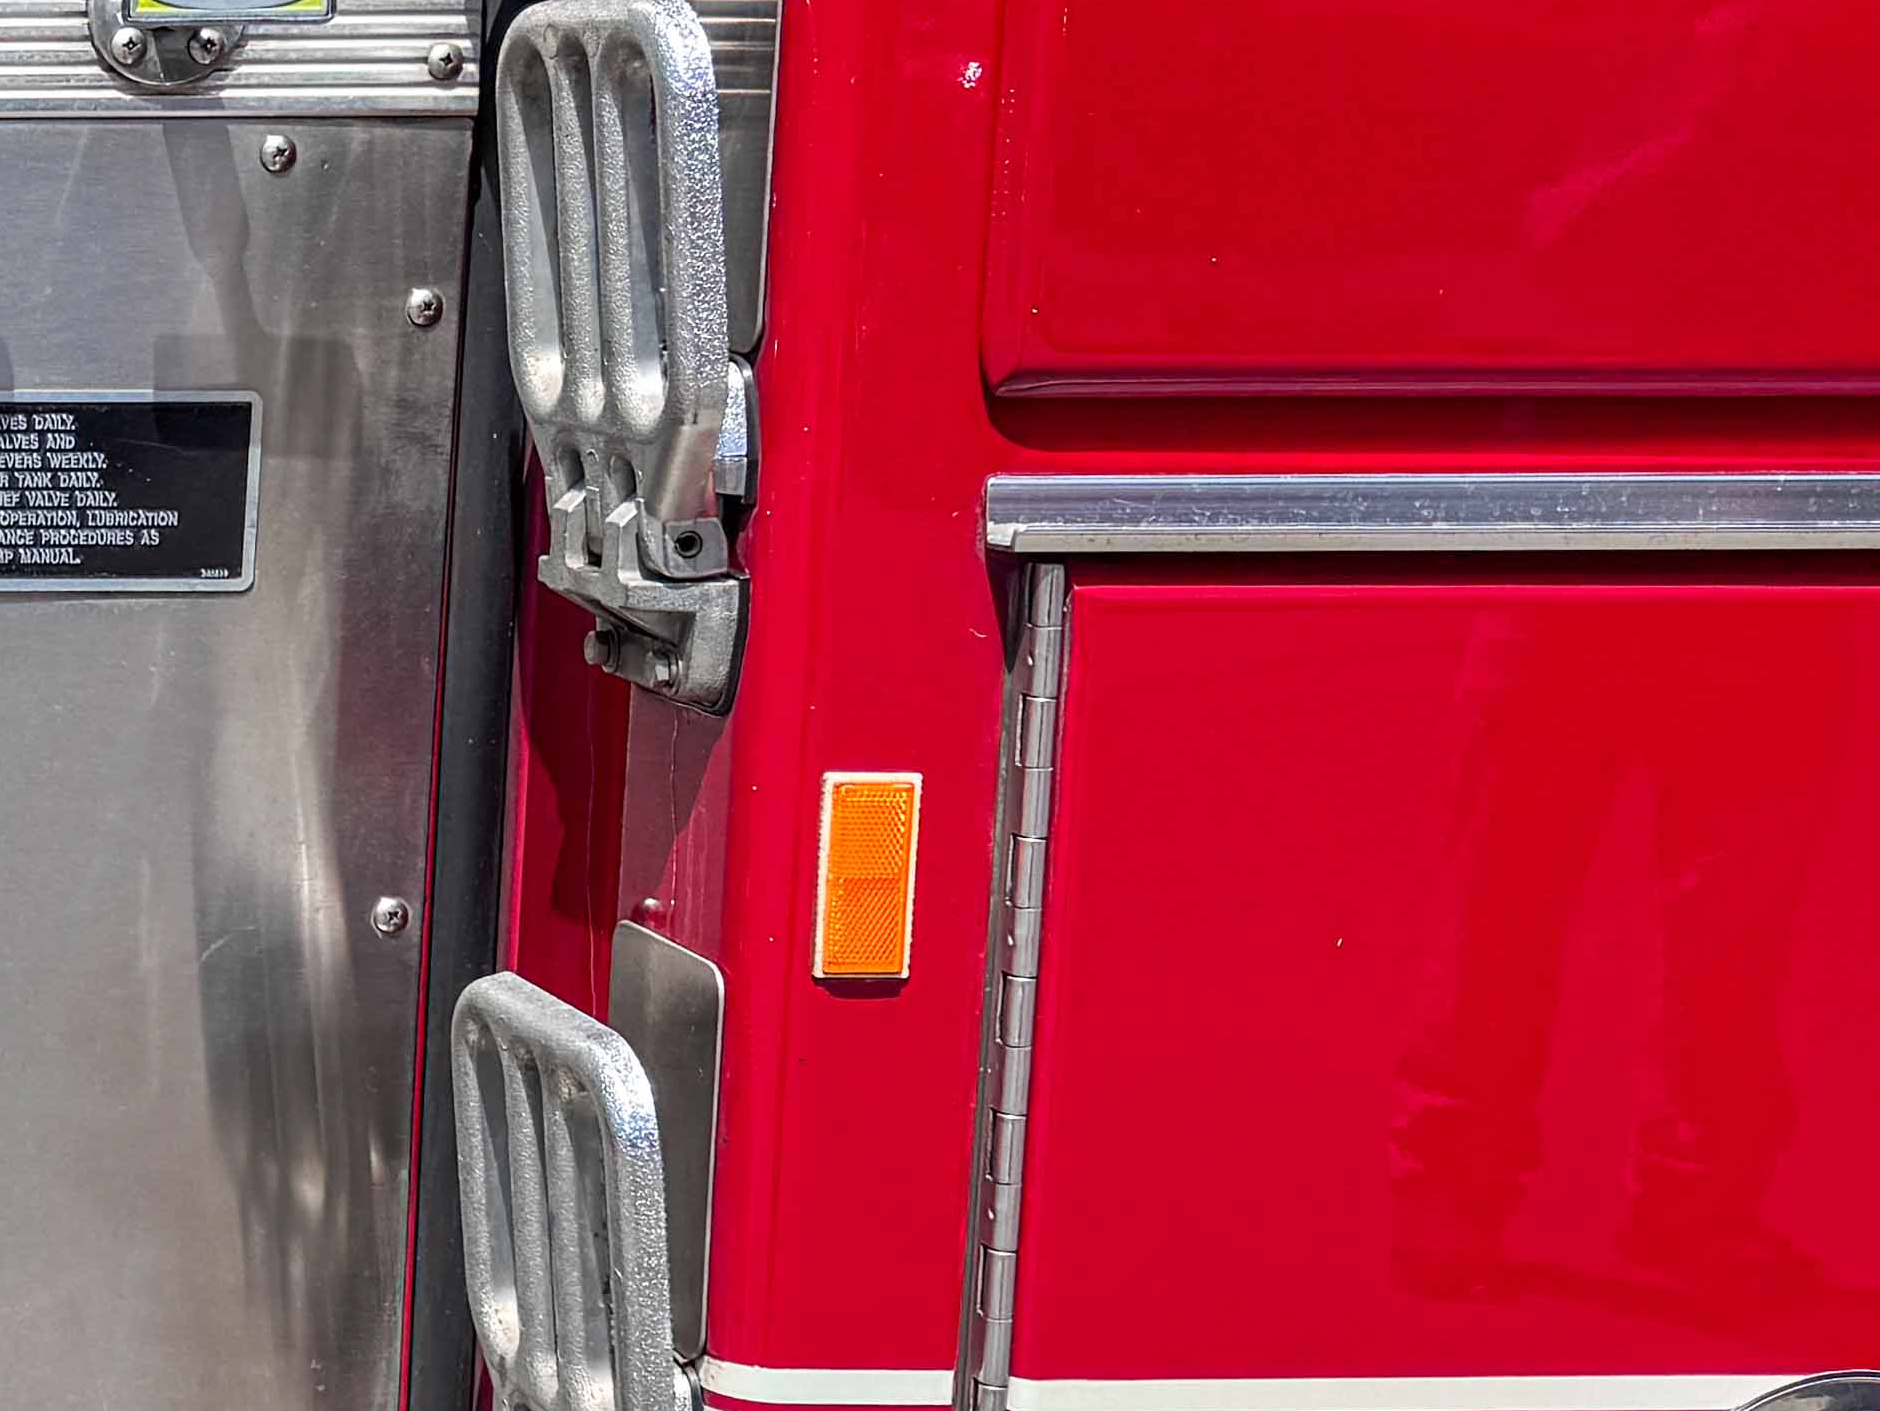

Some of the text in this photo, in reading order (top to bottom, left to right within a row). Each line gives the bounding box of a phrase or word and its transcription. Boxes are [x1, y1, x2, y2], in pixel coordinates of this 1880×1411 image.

[36, 414, 76, 431] DAILY.
[46, 434, 76, 449] AND
[48, 453, 107, 469] WEEKLY.
